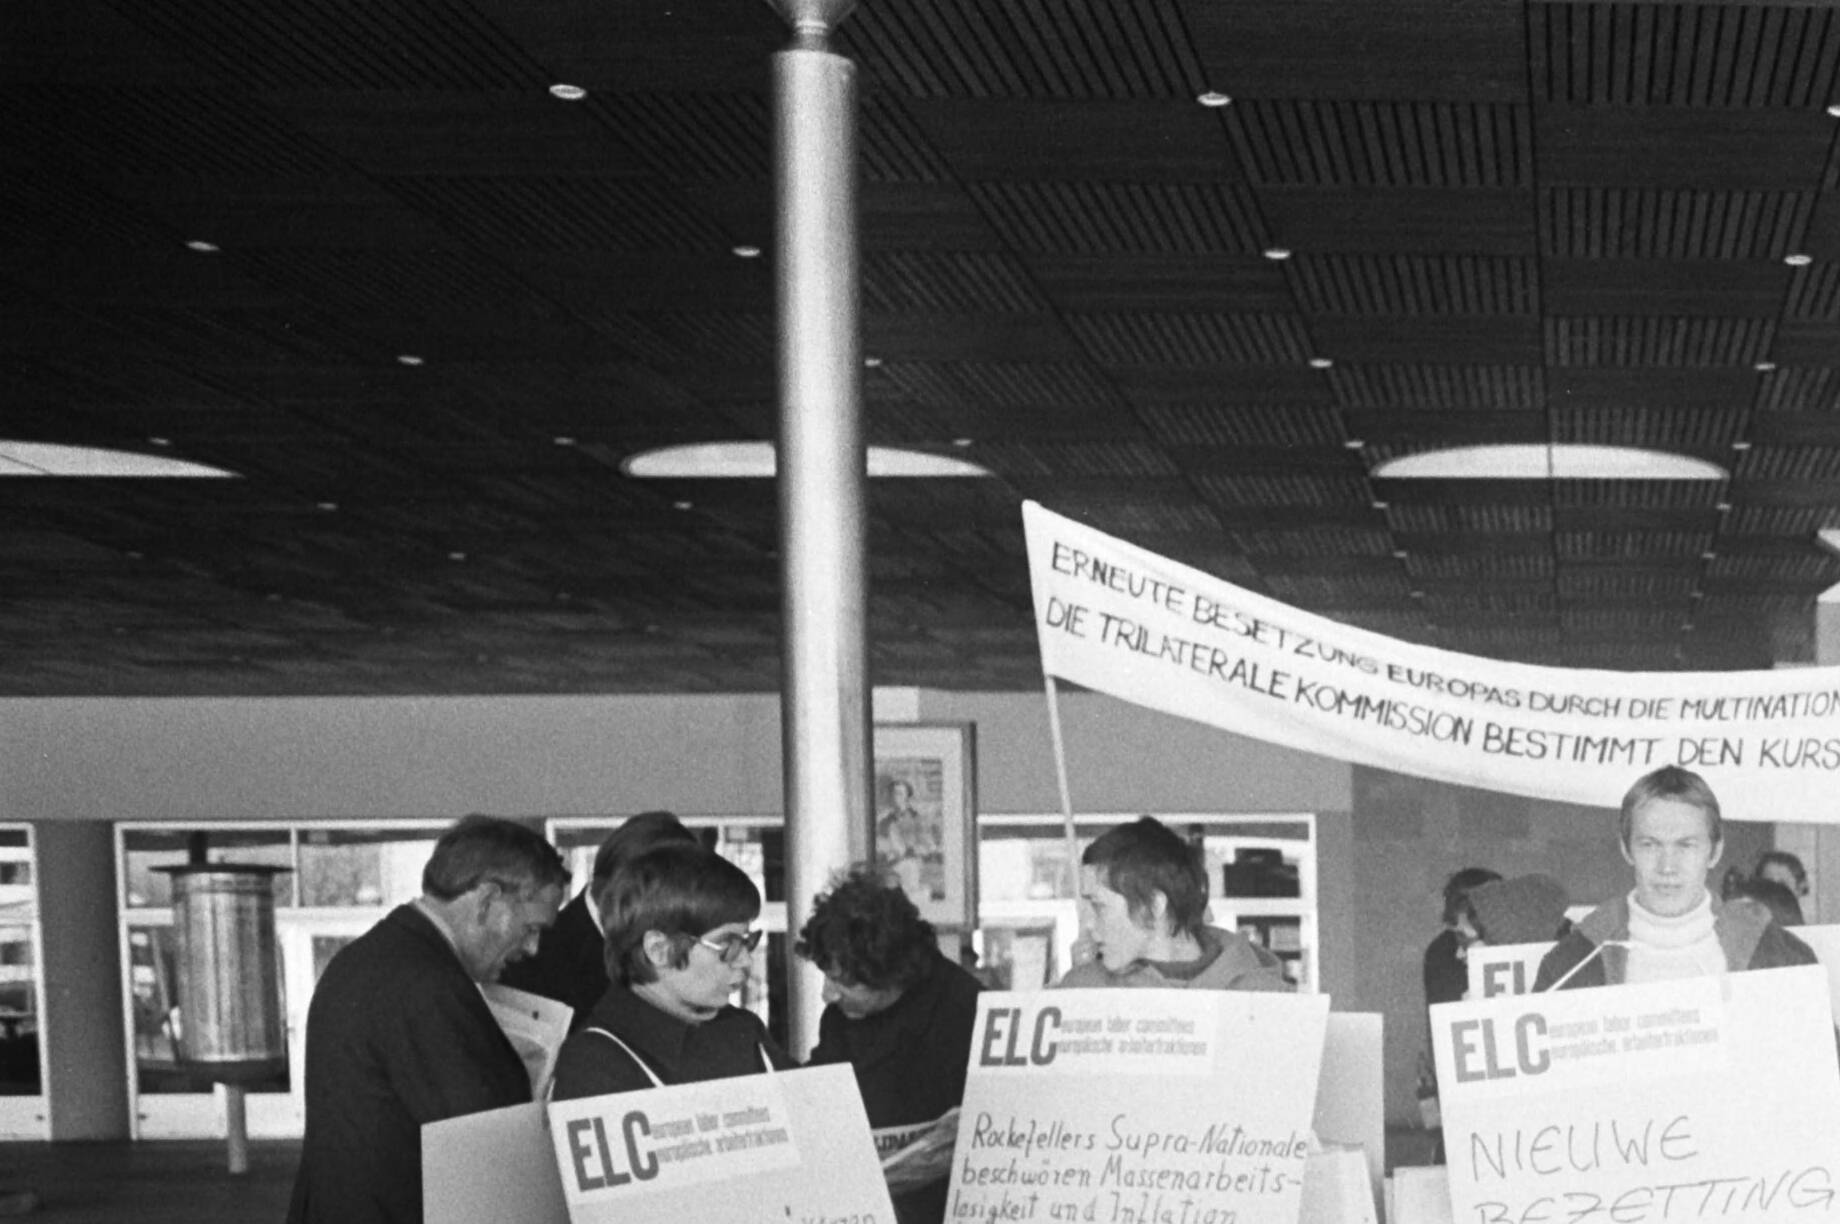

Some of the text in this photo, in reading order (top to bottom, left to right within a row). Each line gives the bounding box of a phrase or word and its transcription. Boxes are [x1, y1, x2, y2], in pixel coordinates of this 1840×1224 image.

[1051, 541, 1184, 615] ERNEUTE
[1193, 595, 1379, 675] BESETZUNG
[1387, 663, 1520, 708] EUROPAS
[1528, 690, 1620, 719] DURCH
[1628, 698, 1668, 719] DIE
[1046, 597, 1088, 638] DIE
[1099, 611, 1291, 700] TRILATERALE
[1296, 677, 1473, 746] KOMMISSION
[1482, 721, 1661, 765] BESTIMMT
[1678, 737, 1743, 767] DEN
[1759, 738, 1840, 770] KURS
[979, 1006, 1062, 1067] ELC
[1450, 1012, 1551, 1083] ELC
[566, 1110, 659, 1192] ELC
[971, 1111, 1095, 1158] Rockefellers
[1471, 1116, 1698, 1181] NIEUWE
[962, 1156, 1091, 1188] beschwören
[1050, 1194, 1096, 1223] und
